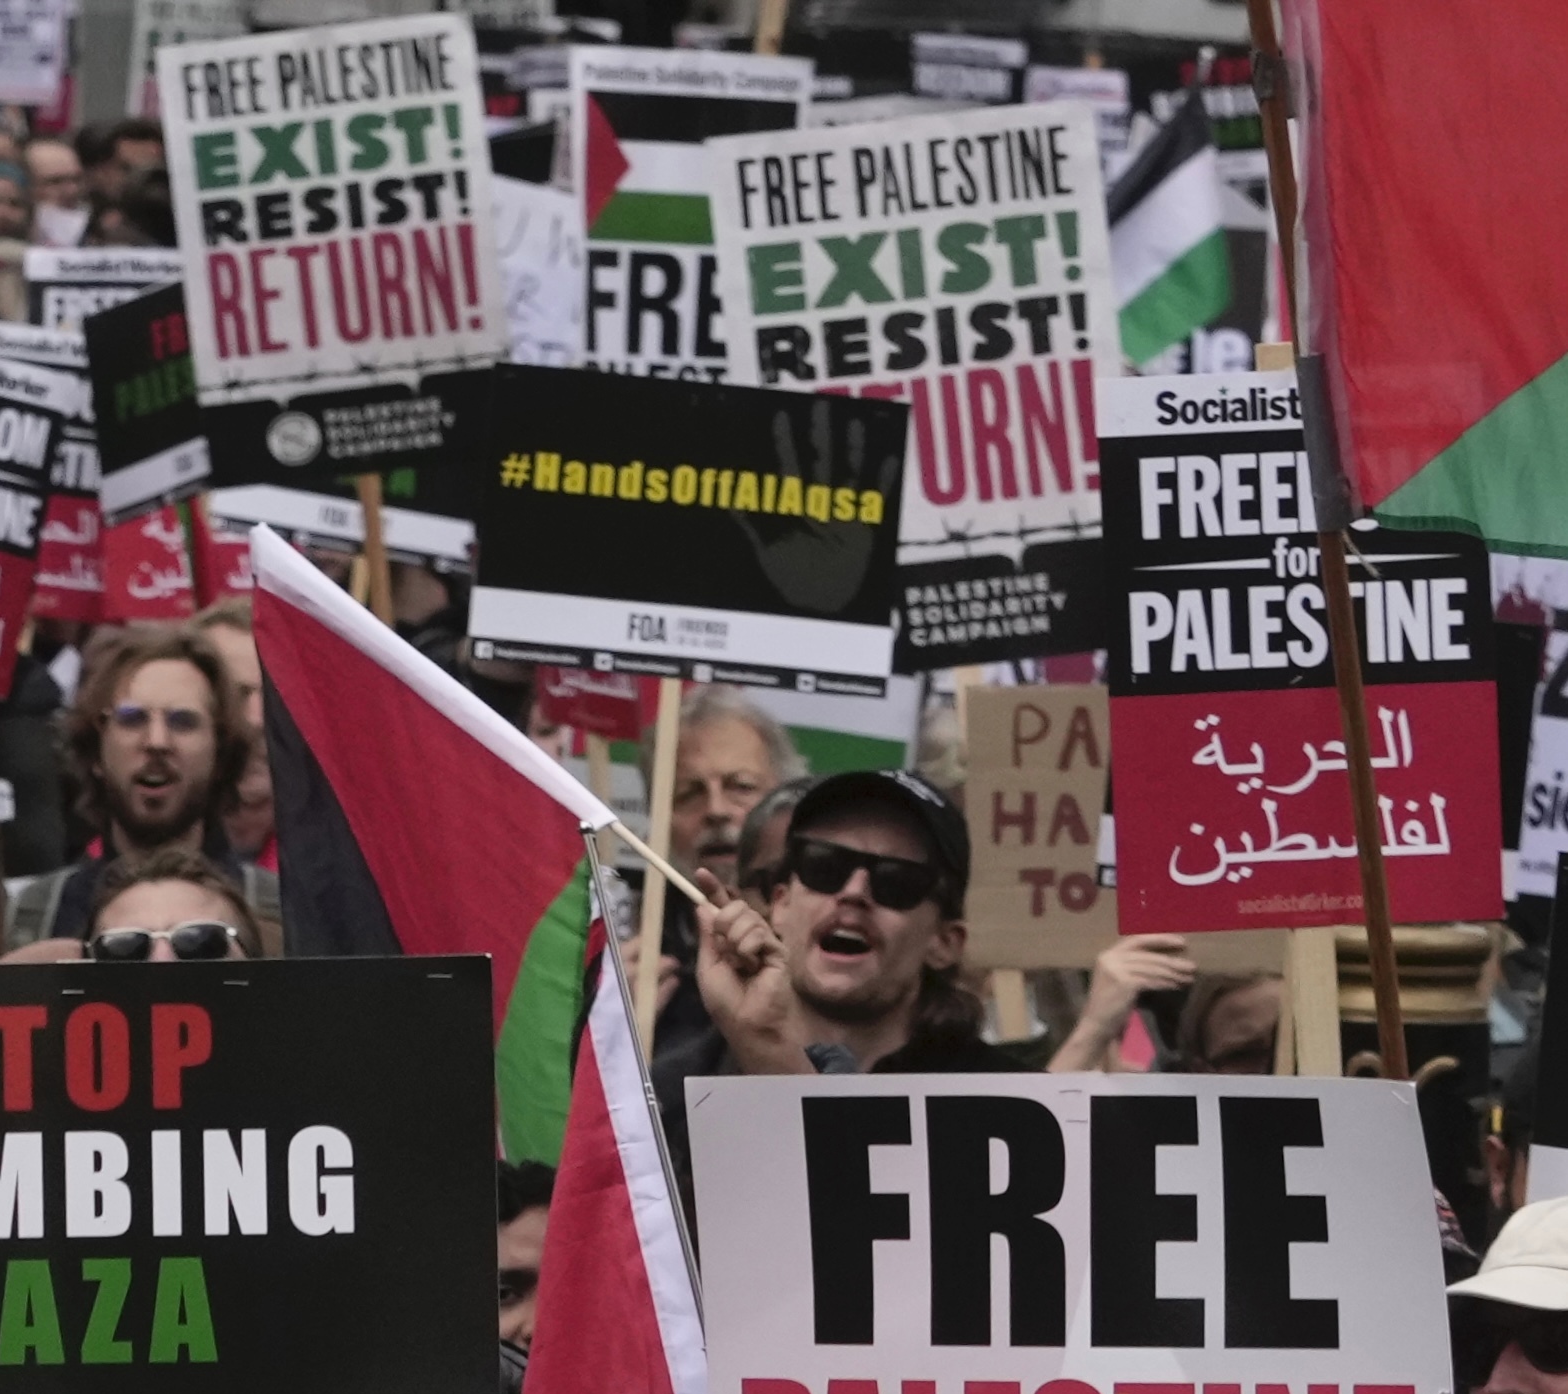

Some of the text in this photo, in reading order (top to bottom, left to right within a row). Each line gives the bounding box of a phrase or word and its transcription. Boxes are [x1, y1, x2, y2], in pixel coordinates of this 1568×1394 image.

[180, 33, 455, 119] FREE PALESTINE
[192, 103, 463, 191] EXIST!
[738, 126, 1074, 230] FREE PALESTINE
[201, 170, 470, 246] RESIST!
[207, 223, 484, 361] RETURN!
[586, 249, 725, 358] FRE
[745, 211, 1083, 316] EXIST!
[756, 292, 1088, 383] RESIST!
[1157, 386, 1302, 427] Socialist
[499, 450, 885, 525] #HandsOffAlAqsa
[905, 573, 1050, 607] PALESTINE
[1272, 540, 1320, 578] for
[907, 592, 1066, 628] SOLIDARITY
[909, 614, 1052, 648] CAMPAIGN
[1193, 709, 1413, 795] الحرية
[1168, 795, 1450, 885] لفلسطين
[801, 1094, 1340, 1350] FREE
